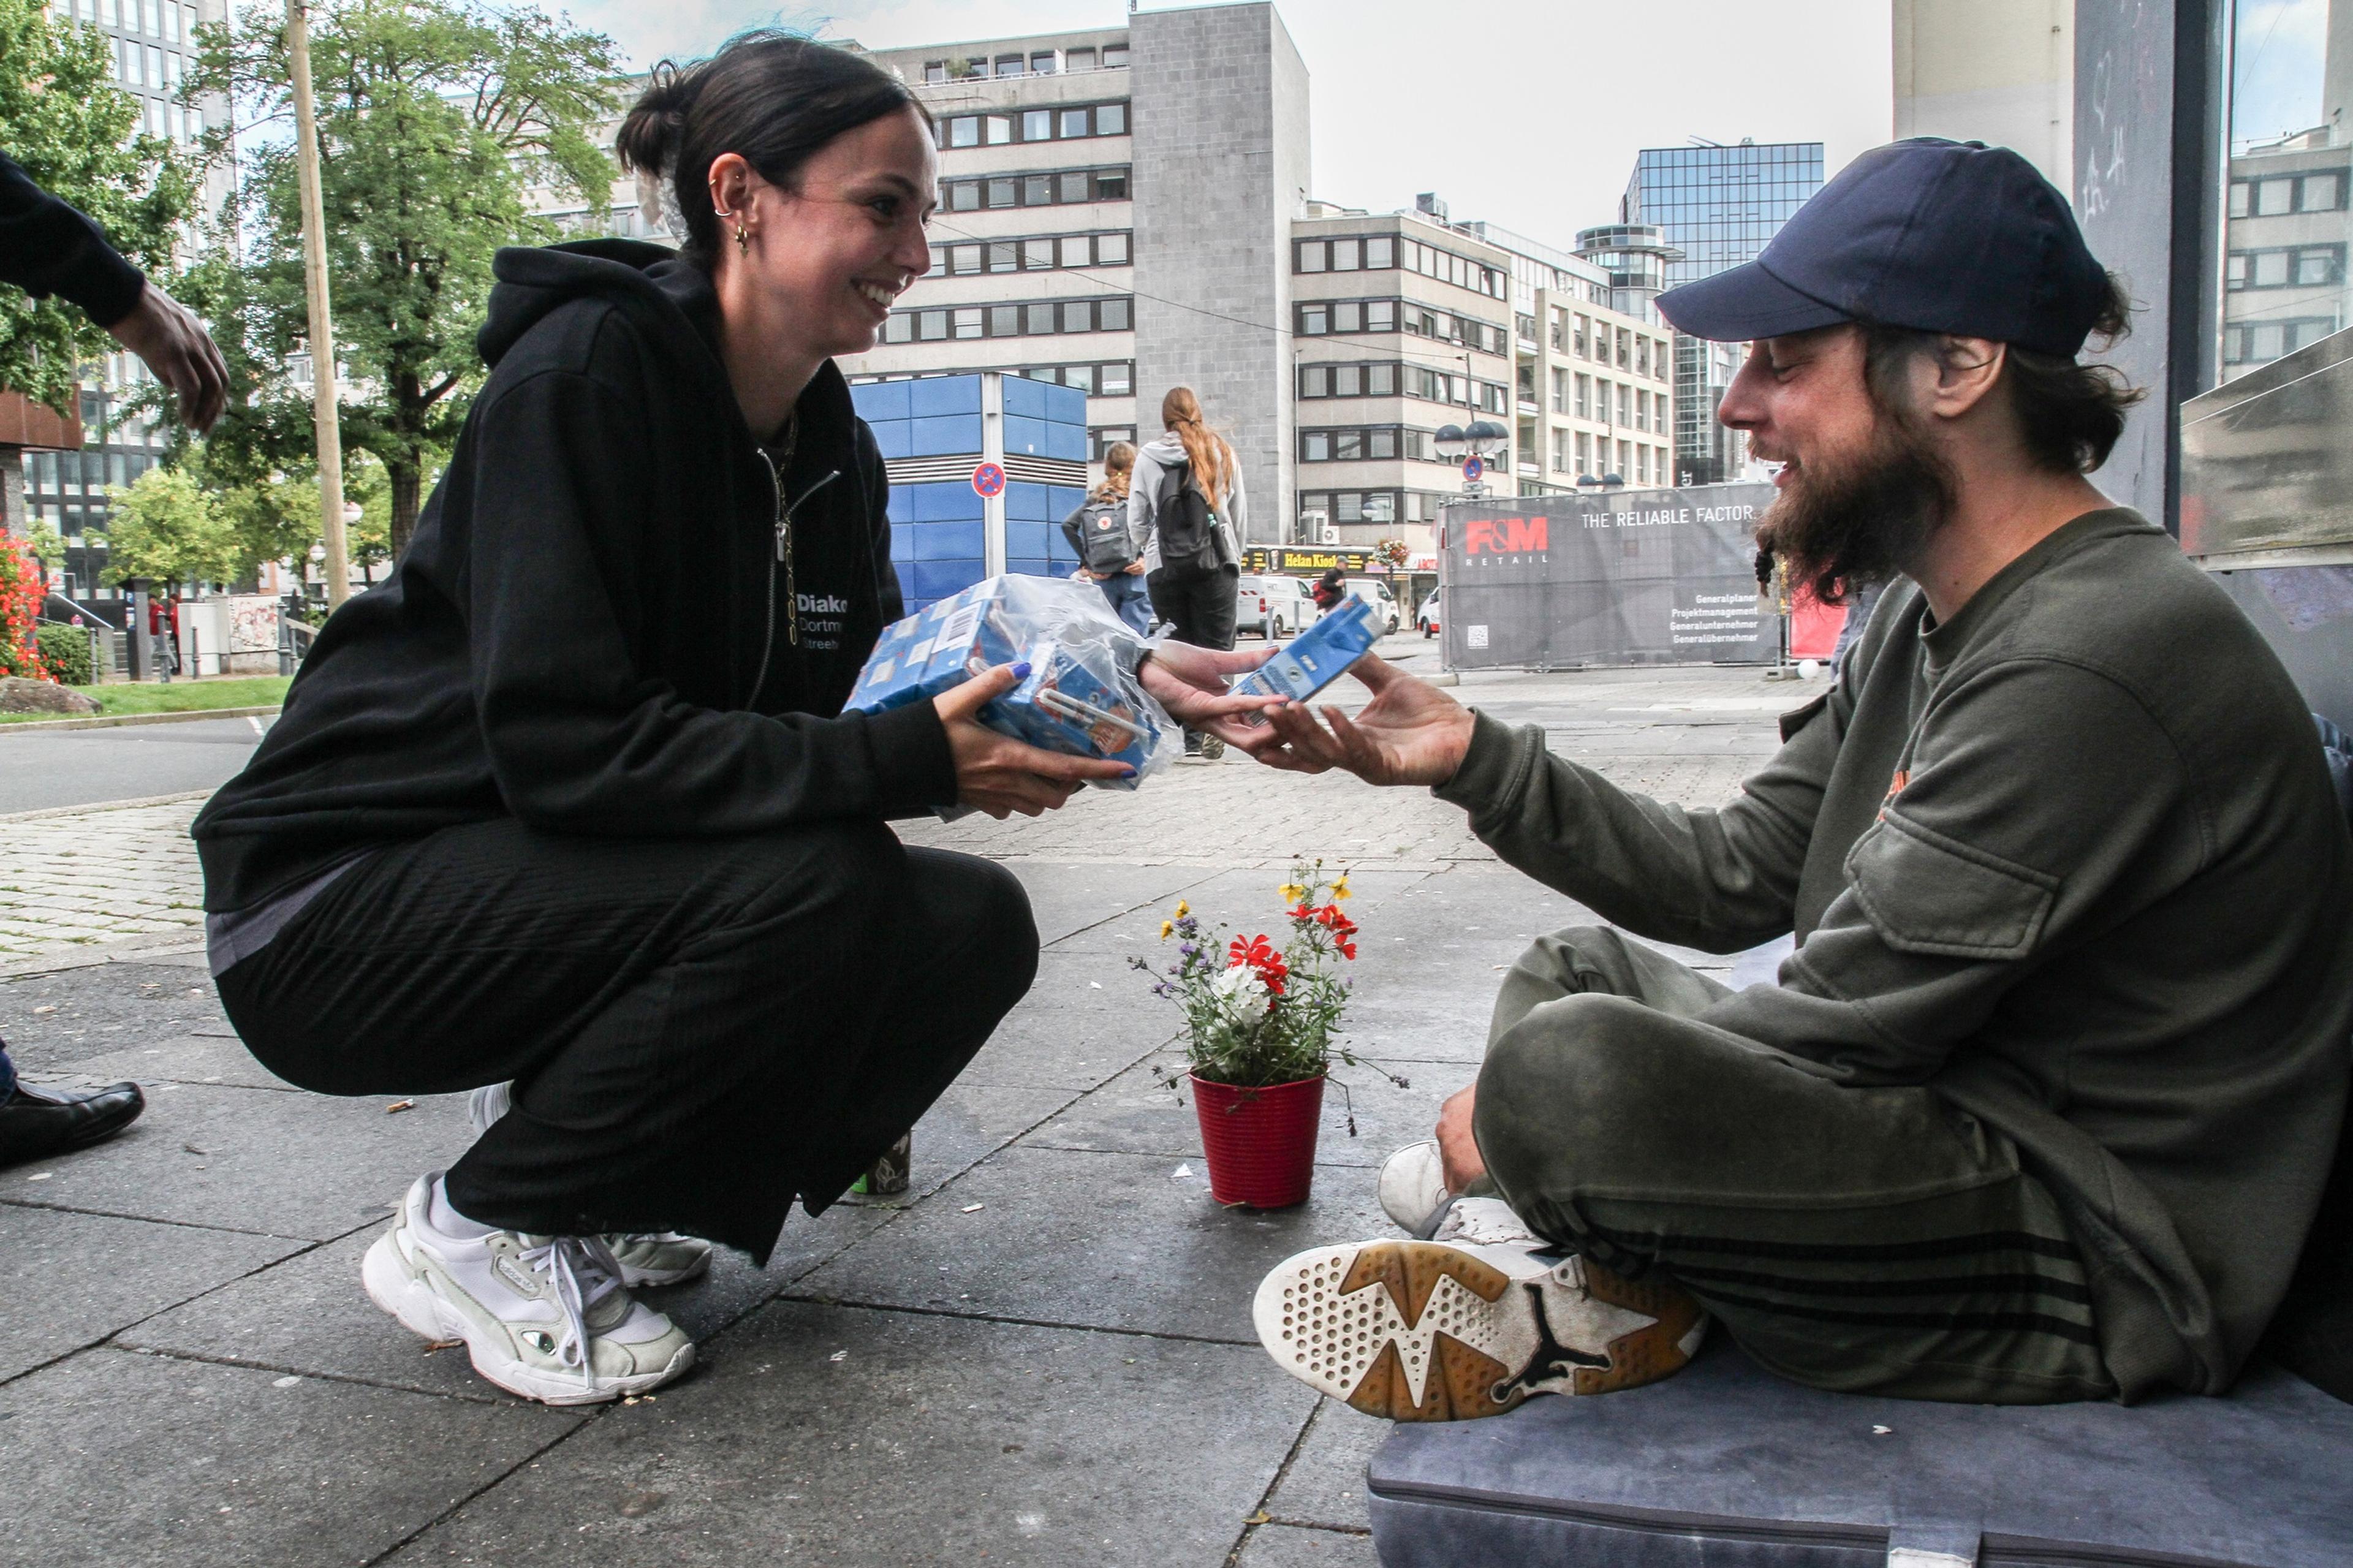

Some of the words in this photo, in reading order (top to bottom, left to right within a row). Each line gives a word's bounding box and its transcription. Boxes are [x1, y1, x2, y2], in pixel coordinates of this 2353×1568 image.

[1582, 513, 1609, 529] THE
[1616, 508, 1689, 527] RELIABLE
[1696, 505, 1757, 522] FACTOR.
[1466, 517, 1548, 555] F&M
[1284, 553, 1312, 567] Helan
[1466, 555, 1548, 566] RETAIL
[1696, 594, 1758, 605] Generalplaner
[1671, 606, 1758, 619] Projektmanagement
[1670, 619, 1759, 631] Generalunternehmer
[1673, 632, 1759, 644] Generalübernehmer
